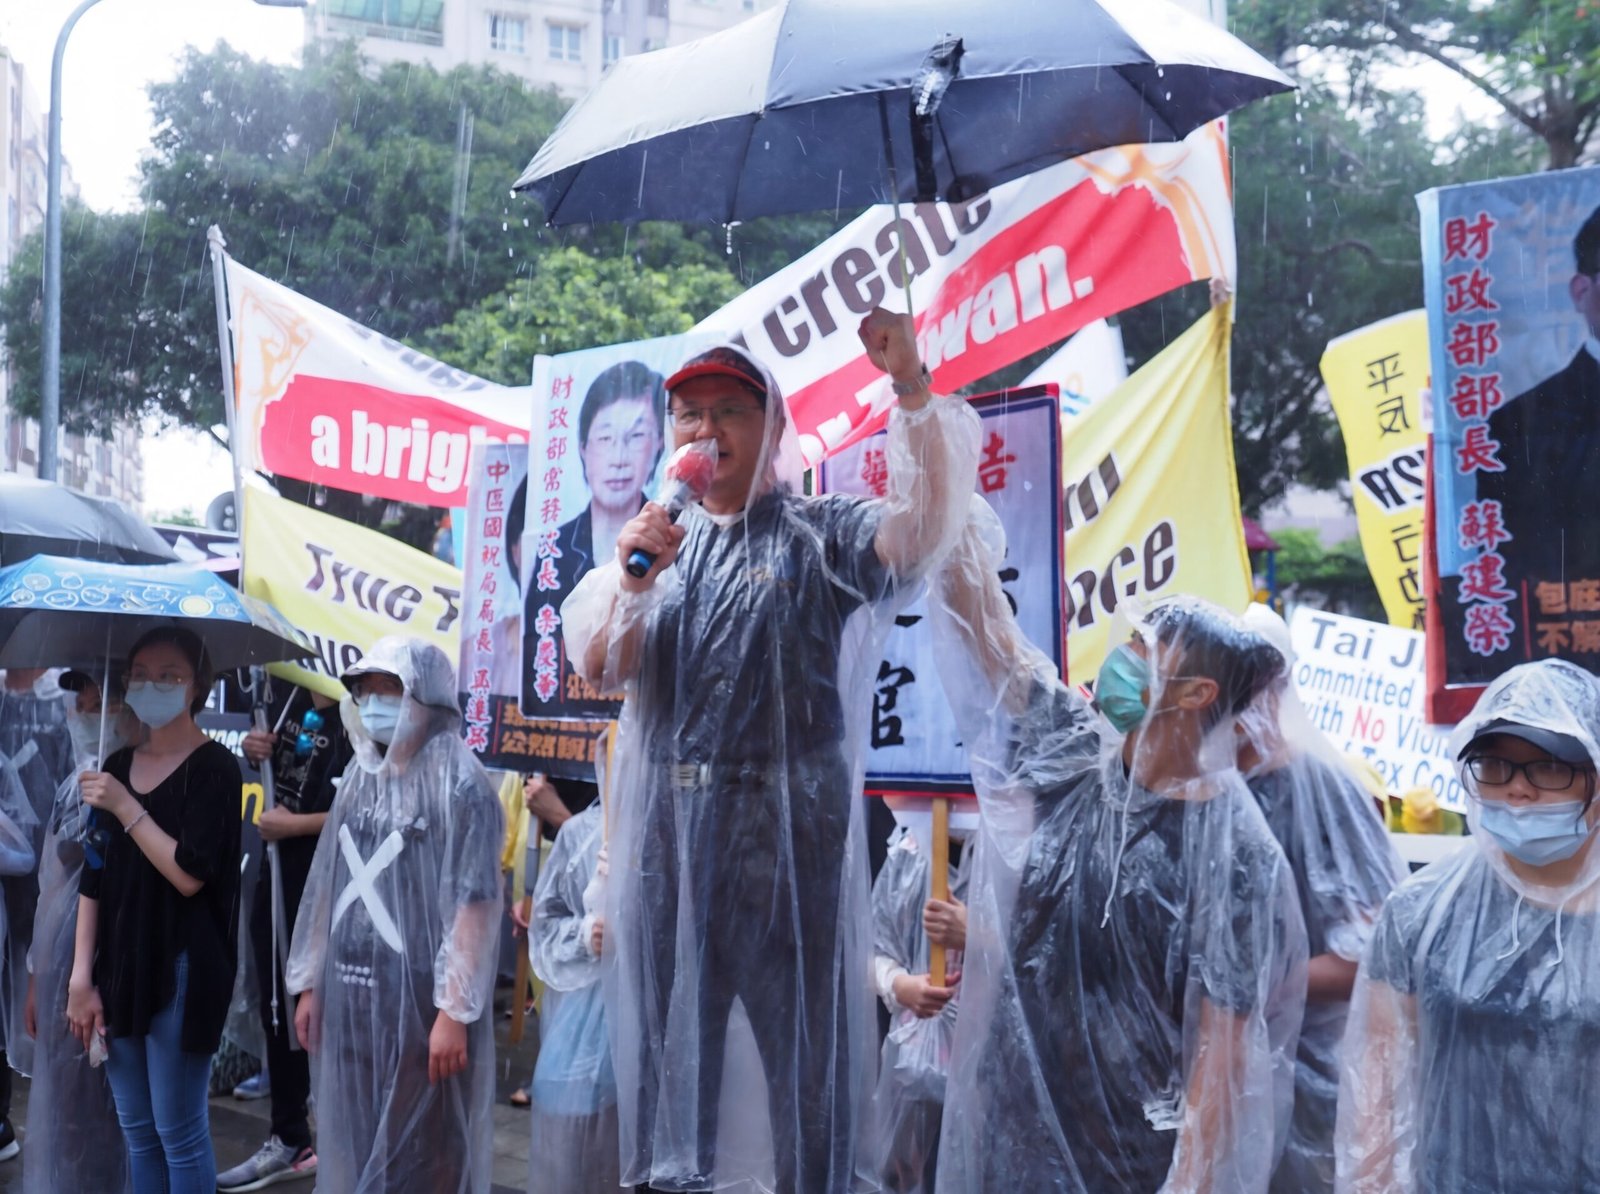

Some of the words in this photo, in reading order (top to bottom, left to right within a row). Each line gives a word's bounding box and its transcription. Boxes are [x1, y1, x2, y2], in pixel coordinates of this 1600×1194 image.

[1443, 211, 1505, 474] 財政部部長
[311, 415, 341, 469] a
[352, 410, 487, 494] brig
[305, 543, 423, 622] True
[1458, 501, 1517, 656] 蘇建榮
[1311, 617, 1377, 660] Tai
[1390, 637, 1419, 669] J
[1299, 663, 1415, 708] ommitted
[1352, 705, 1385, 742] No
